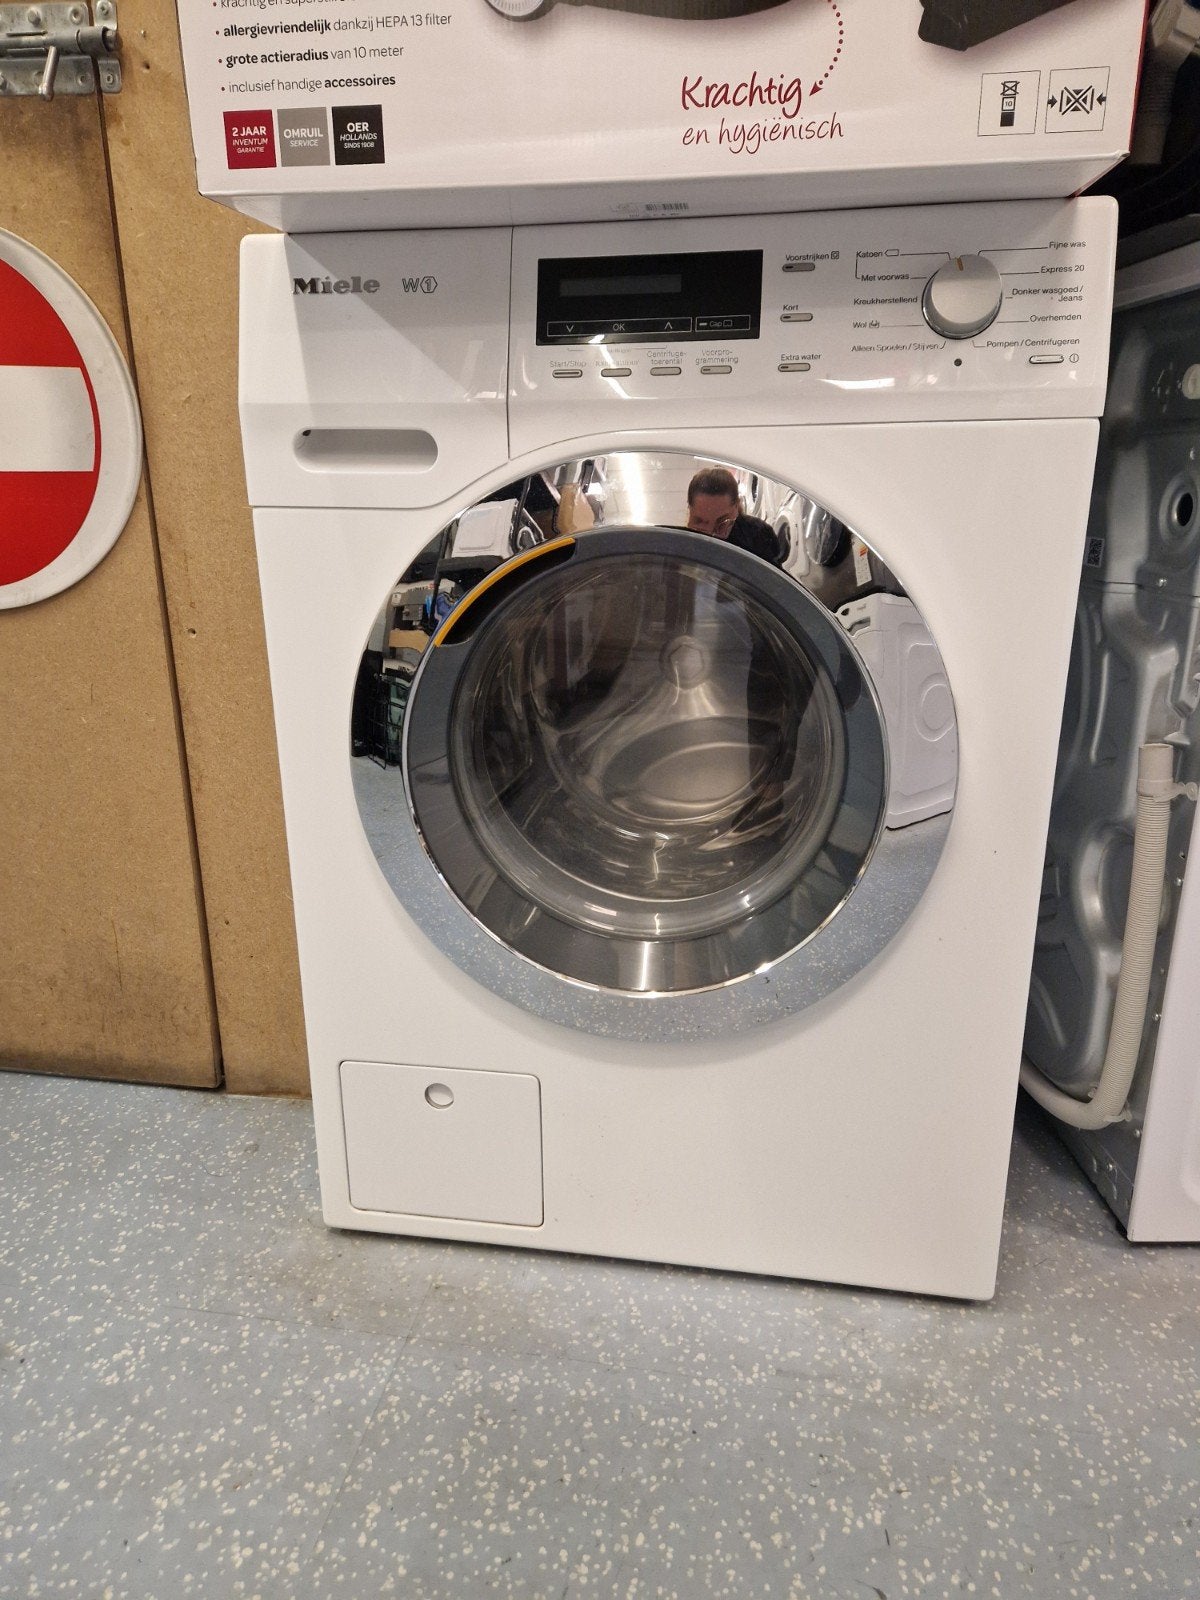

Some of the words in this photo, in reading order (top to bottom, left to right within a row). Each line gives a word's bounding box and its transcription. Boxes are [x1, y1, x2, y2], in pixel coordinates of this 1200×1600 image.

[223, 19, 332, 39] allergievriendelijk
[333, 16, 374, 31] dankzij
[376, 15, 409, 28] HEPA
[410, 14, 423, 26] 13
[425, 13, 452, 26] filter
[226, 53, 258, 68] grote
[260, 48, 329, 64] actieradius
[330, 49, 351, 59] van
[353, 46, 366, 58] 10
[369, 46, 404, 57] meter
[228, 78, 275, 93] inclusief
[277, 77, 322, 92] handige
[324, 74, 396, 88] accessoires
[681, 71, 802, 119] Krachtig
[231, 127, 238, 137] 2
[240, 126, 267, 136] JAAR
[346, 122, 369, 133] OER
[283, 127, 324, 139] OMRUIL
[339, 132, 378, 142] HOLLANDS
[682, 127, 710, 145] en
[719, 112, 843, 154] hygiënisch
[232, 138, 268, 146] INVENTUM
[289, 139, 319, 148] SERVICE
[236, 146, 265, 154] GARANTIE
[1049, 241, 1068, 250] Fijne
[785, 252, 830, 262] Voorstrijken
[856, 250, 883, 258] Katoen
[1040, 265, 1072, 274] Express
[861, 274, 876, 282] Met
[877, 273, 909, 281] voorwas
[293, 276, 380, 295] Miele
[1012, 288, 1041, 296] Donker
[1042, 286, 1079, 296] wasgoed
[853, 296, 918, 305] Kreukherstellend
[1058, 294, 1083, 302] Jeans
[1030, 313, 1082, 322] Overhemden
[612, 323, 625, 331] OK
[852, 321, 867, 329] Wol
[987, 340, 1019, 349] Pompen
[1024, 337, 1080, 348] Centrifugeren
[549, 360, 587, 368] Start/Stop
